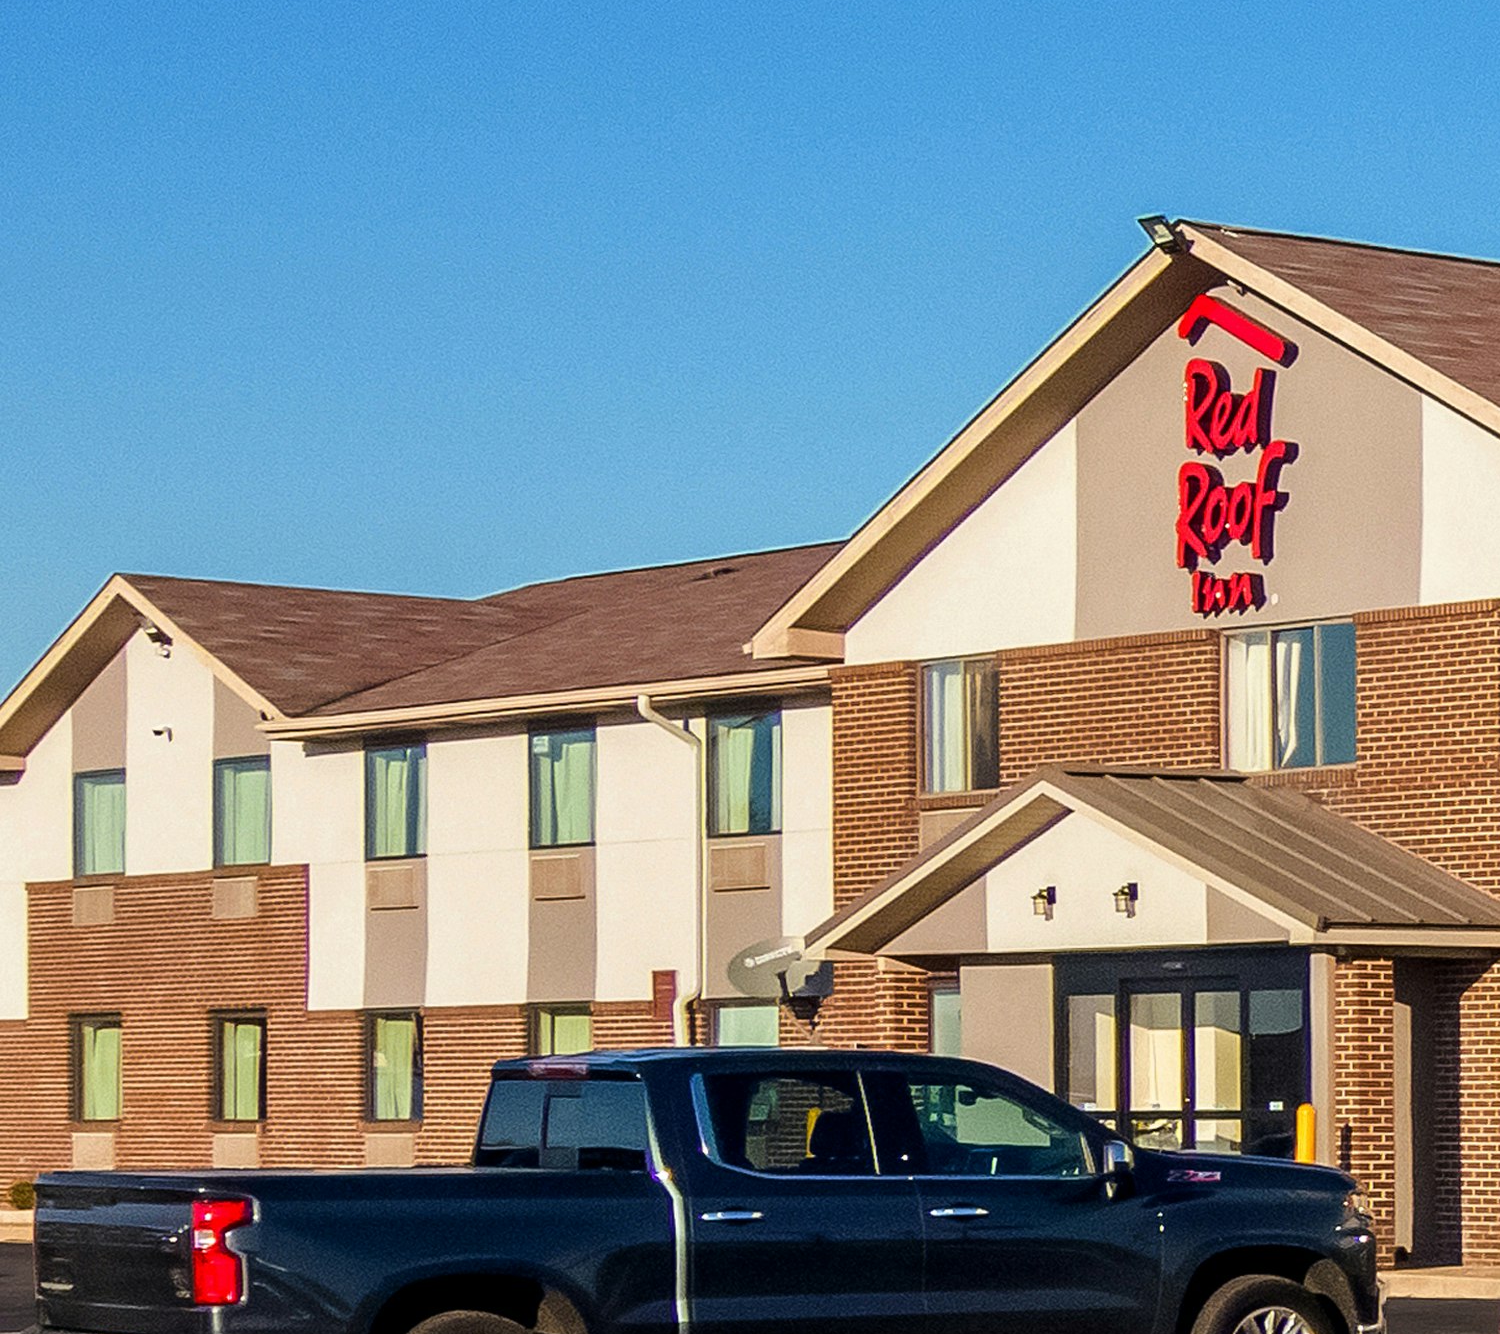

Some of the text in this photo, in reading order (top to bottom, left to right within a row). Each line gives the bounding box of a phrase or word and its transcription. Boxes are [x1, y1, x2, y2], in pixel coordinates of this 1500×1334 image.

[1185, 357, 1268, 455] Red
[1176, 440, 1288, 569] Roof
[1191, 571, 1258, 615] Inn
